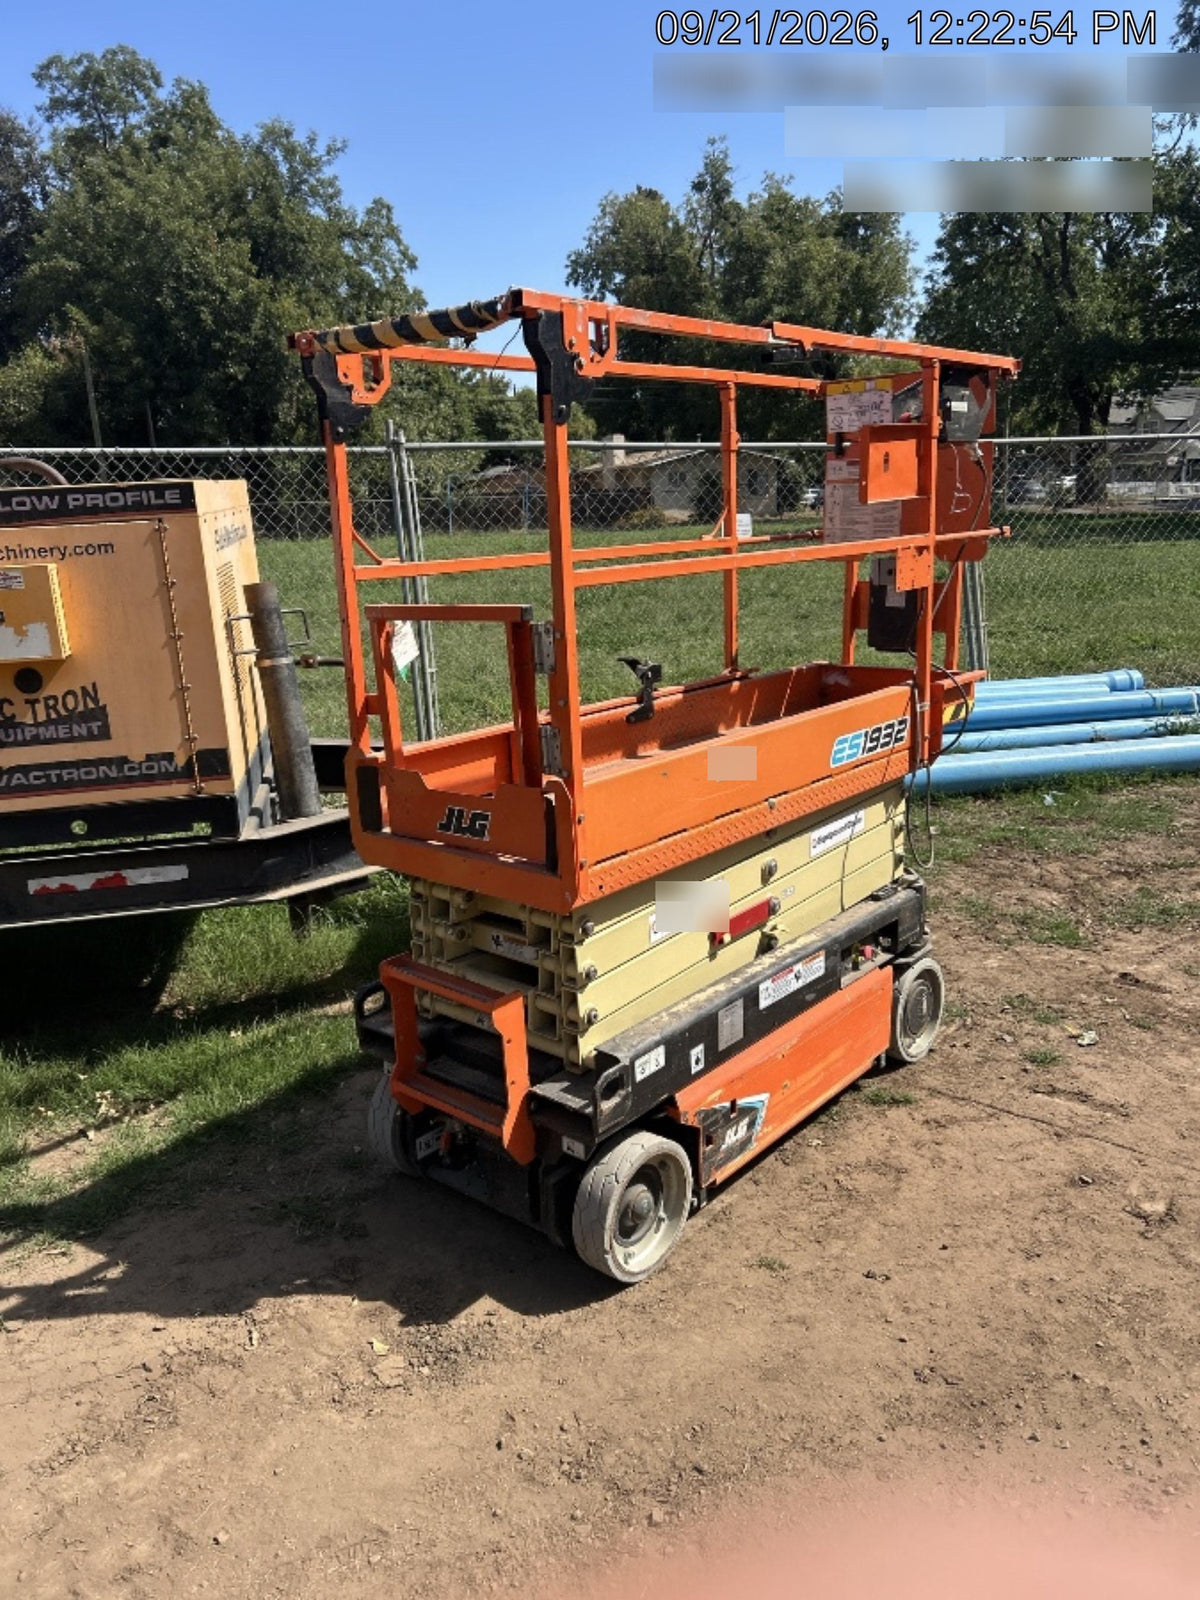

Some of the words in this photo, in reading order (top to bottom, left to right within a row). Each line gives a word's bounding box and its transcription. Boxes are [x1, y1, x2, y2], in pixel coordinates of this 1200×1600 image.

[67, 489, 182, 510] PROFILE
[25, 682, 101, 723] TRON
[830, 715, 910, 768] ES1932
[437, 805, 491, 841] JLG
